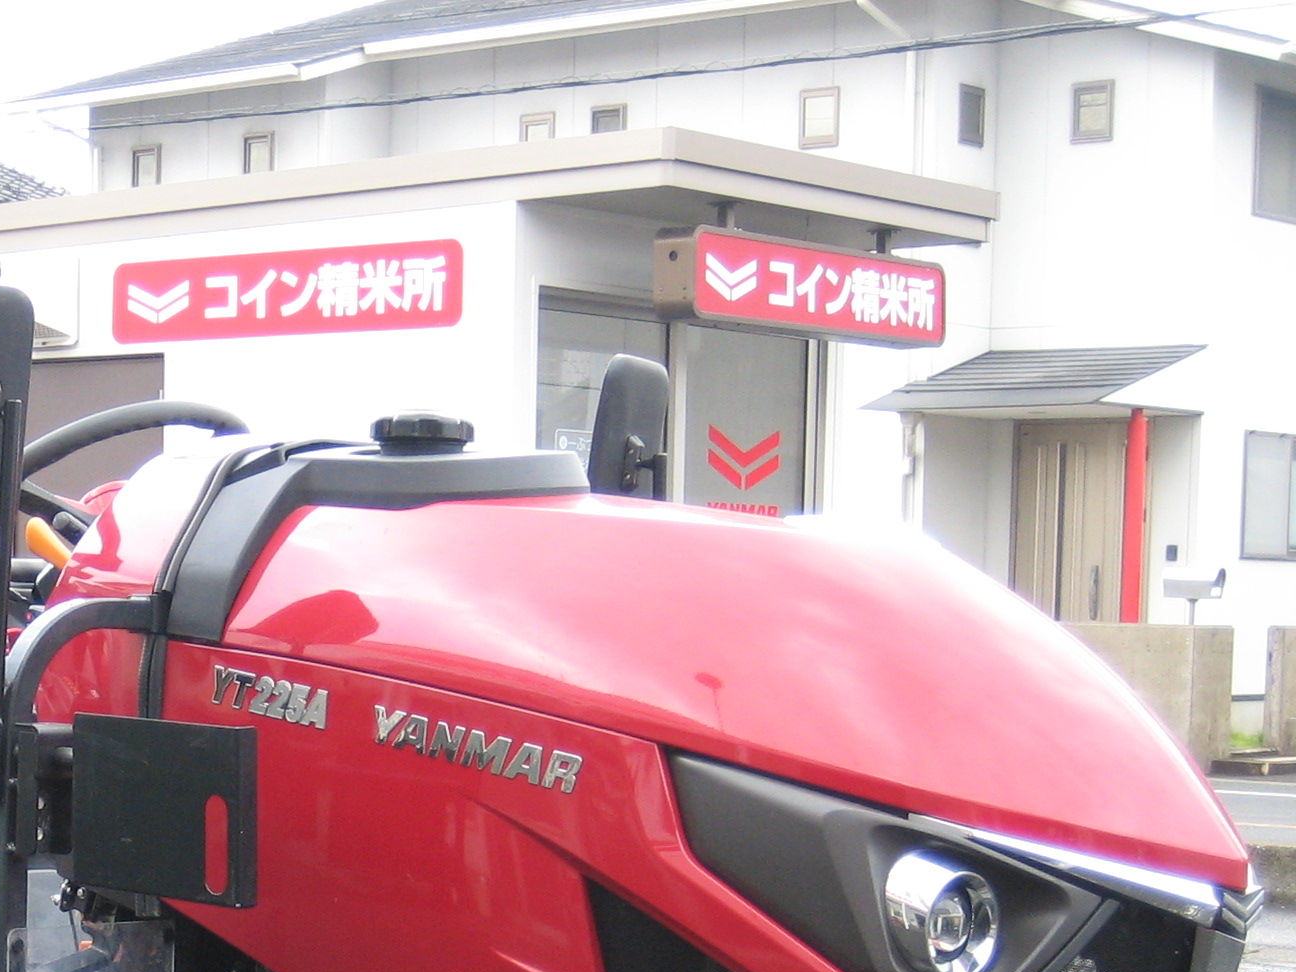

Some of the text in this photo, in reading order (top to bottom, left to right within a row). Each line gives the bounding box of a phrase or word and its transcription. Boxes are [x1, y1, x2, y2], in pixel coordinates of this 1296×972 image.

[204, 255, 447, 319] コイン精米所
[768, 260, 936, 332] コイン精米所
[211, 664, 329, 730] YT225A
[374, 704, 584, 794] YANMAR
